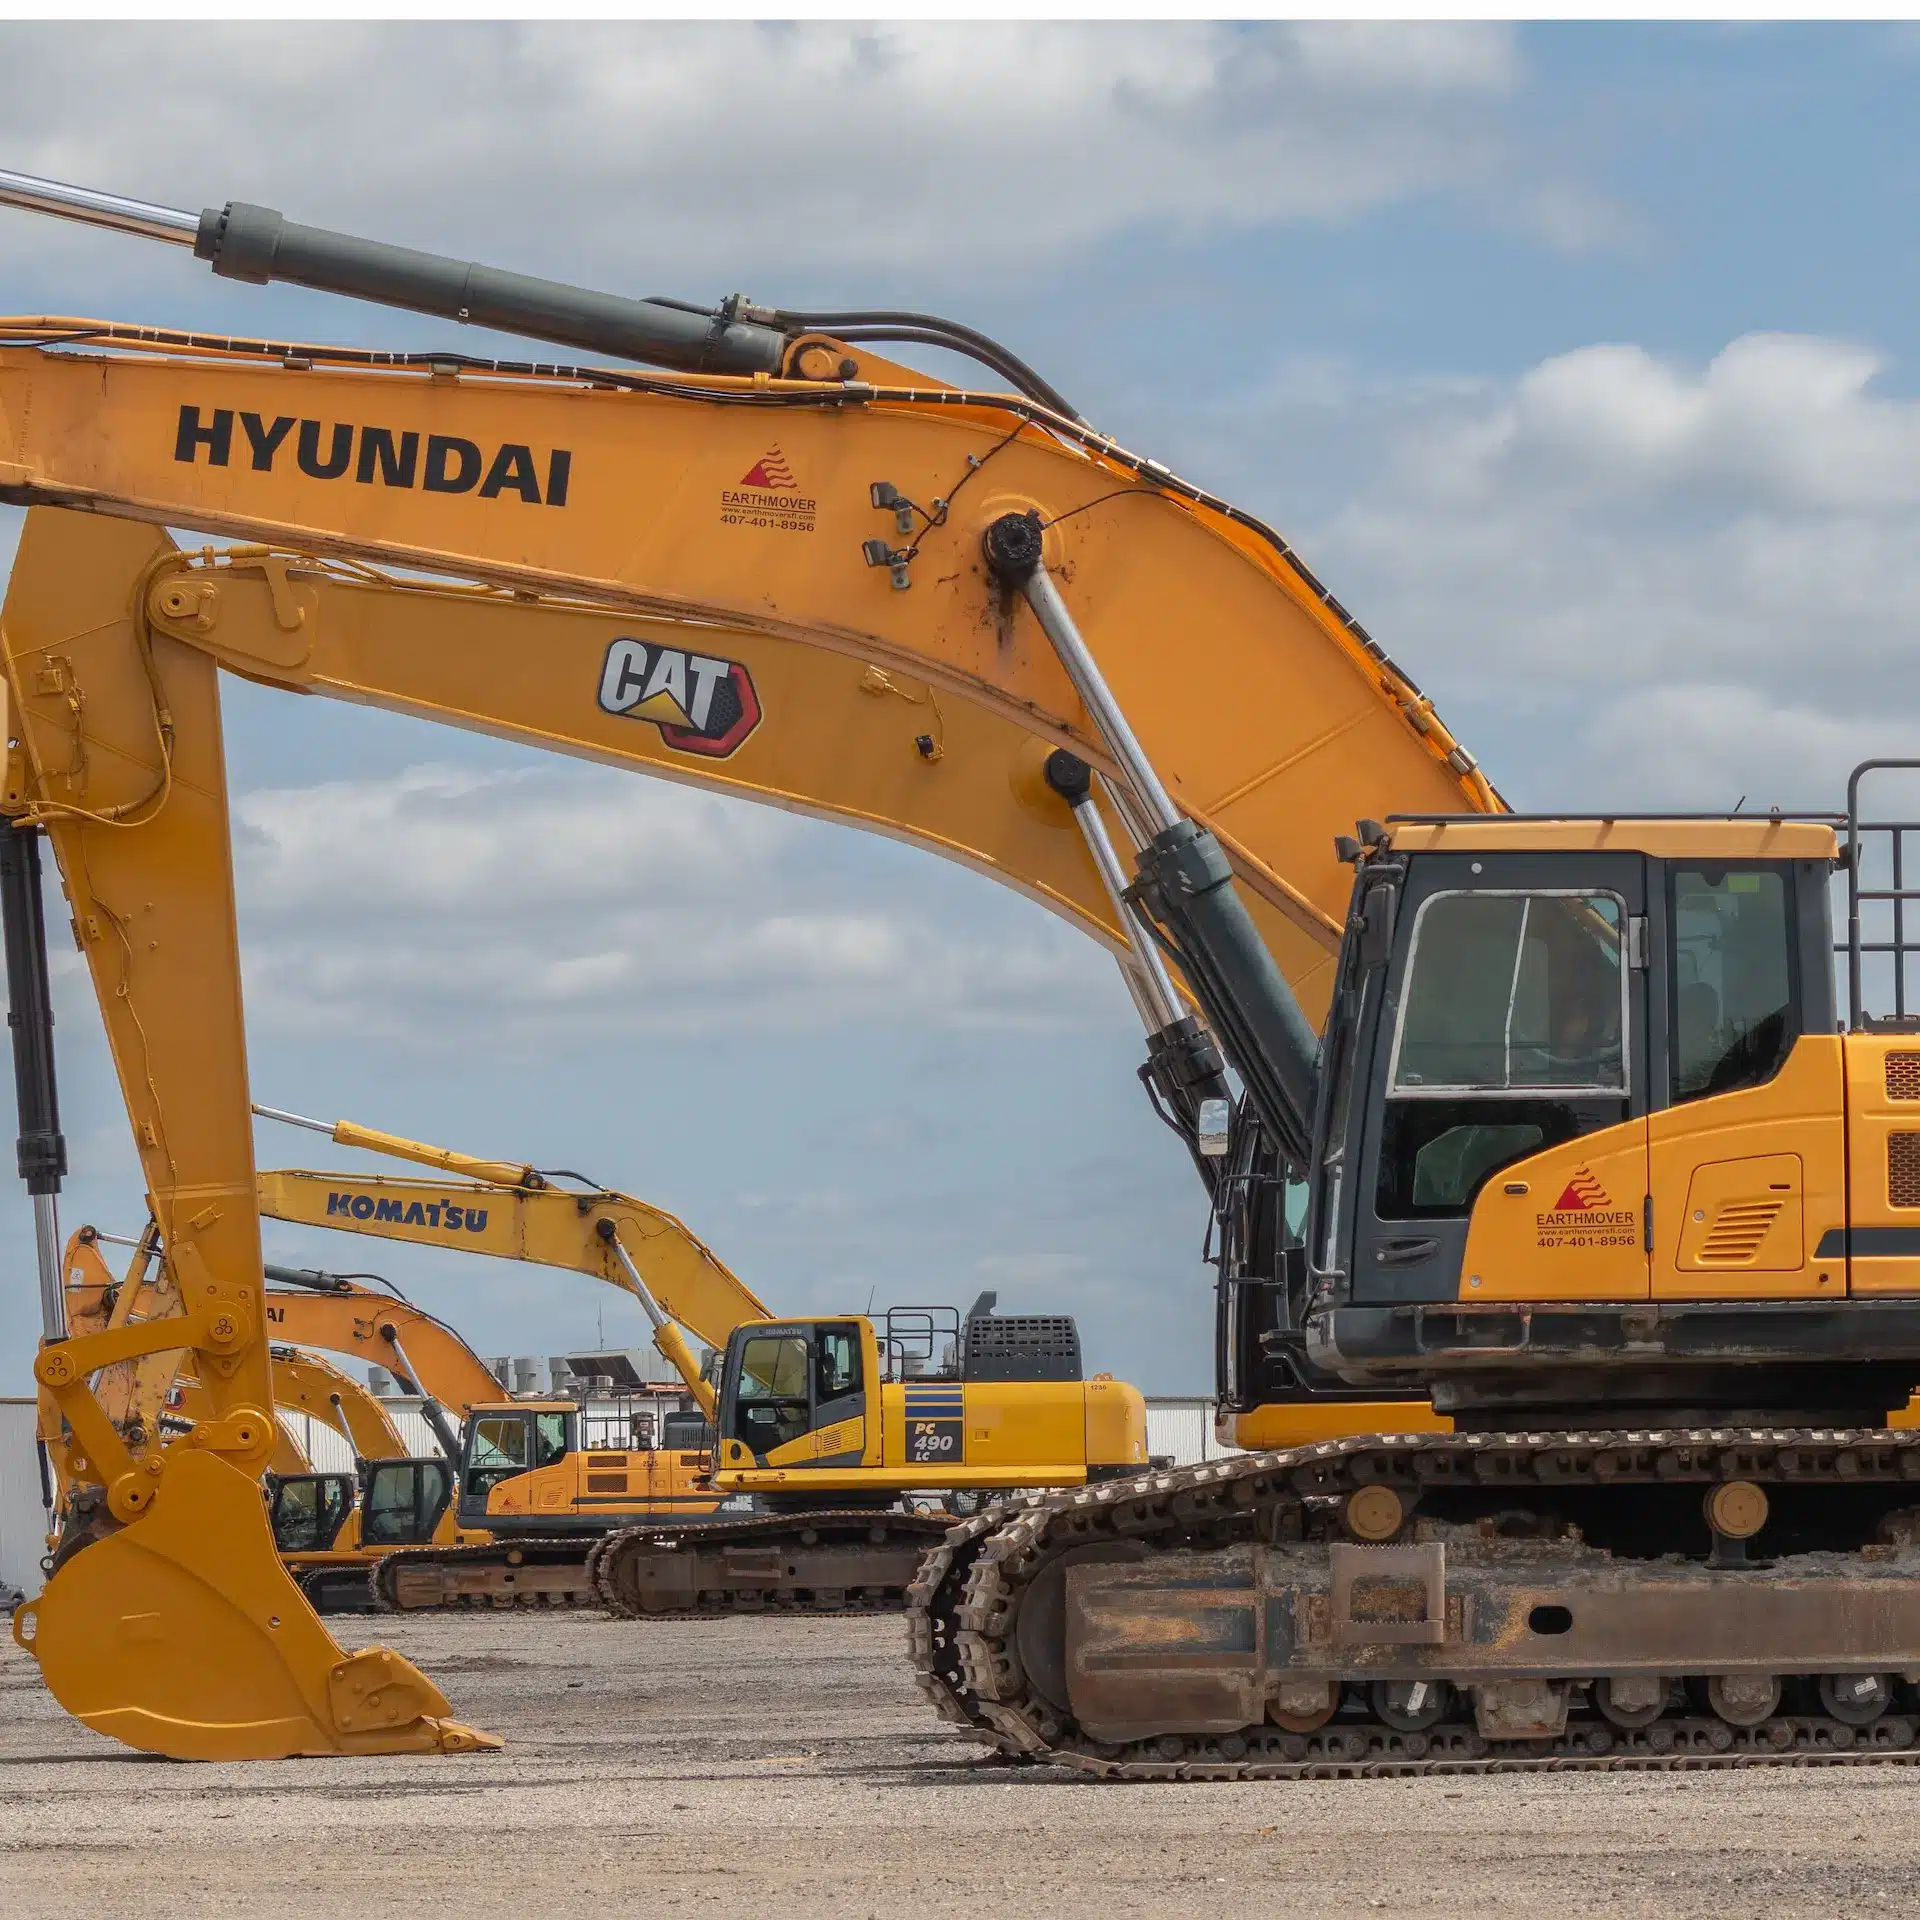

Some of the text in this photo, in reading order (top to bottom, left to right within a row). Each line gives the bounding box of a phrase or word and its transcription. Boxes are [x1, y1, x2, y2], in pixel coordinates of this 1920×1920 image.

[174, 404, 572, 507] HYUNDAI
[722, 491, 816, 510] EARTHMOVER
[721, 506, 816, 520] www.earthmoversfl.com
[720, 514, 815, 532] 407-401-8956
[600, 640, 729, 731] CAT
[326, 1192, 488, 1232] KOMATSU
[1536, 1211, 1634, 1225] EARTHMOVER
[1537, 1228, 1635, 1236] www.earthmoversfl.com
[1537, 1236, 1635, 1247] 407-401-8956
[915, 1423, 935, 1434] PC
[914, 1436, 953, 1450] 490
[915, 1452, 930, 1461] LC
